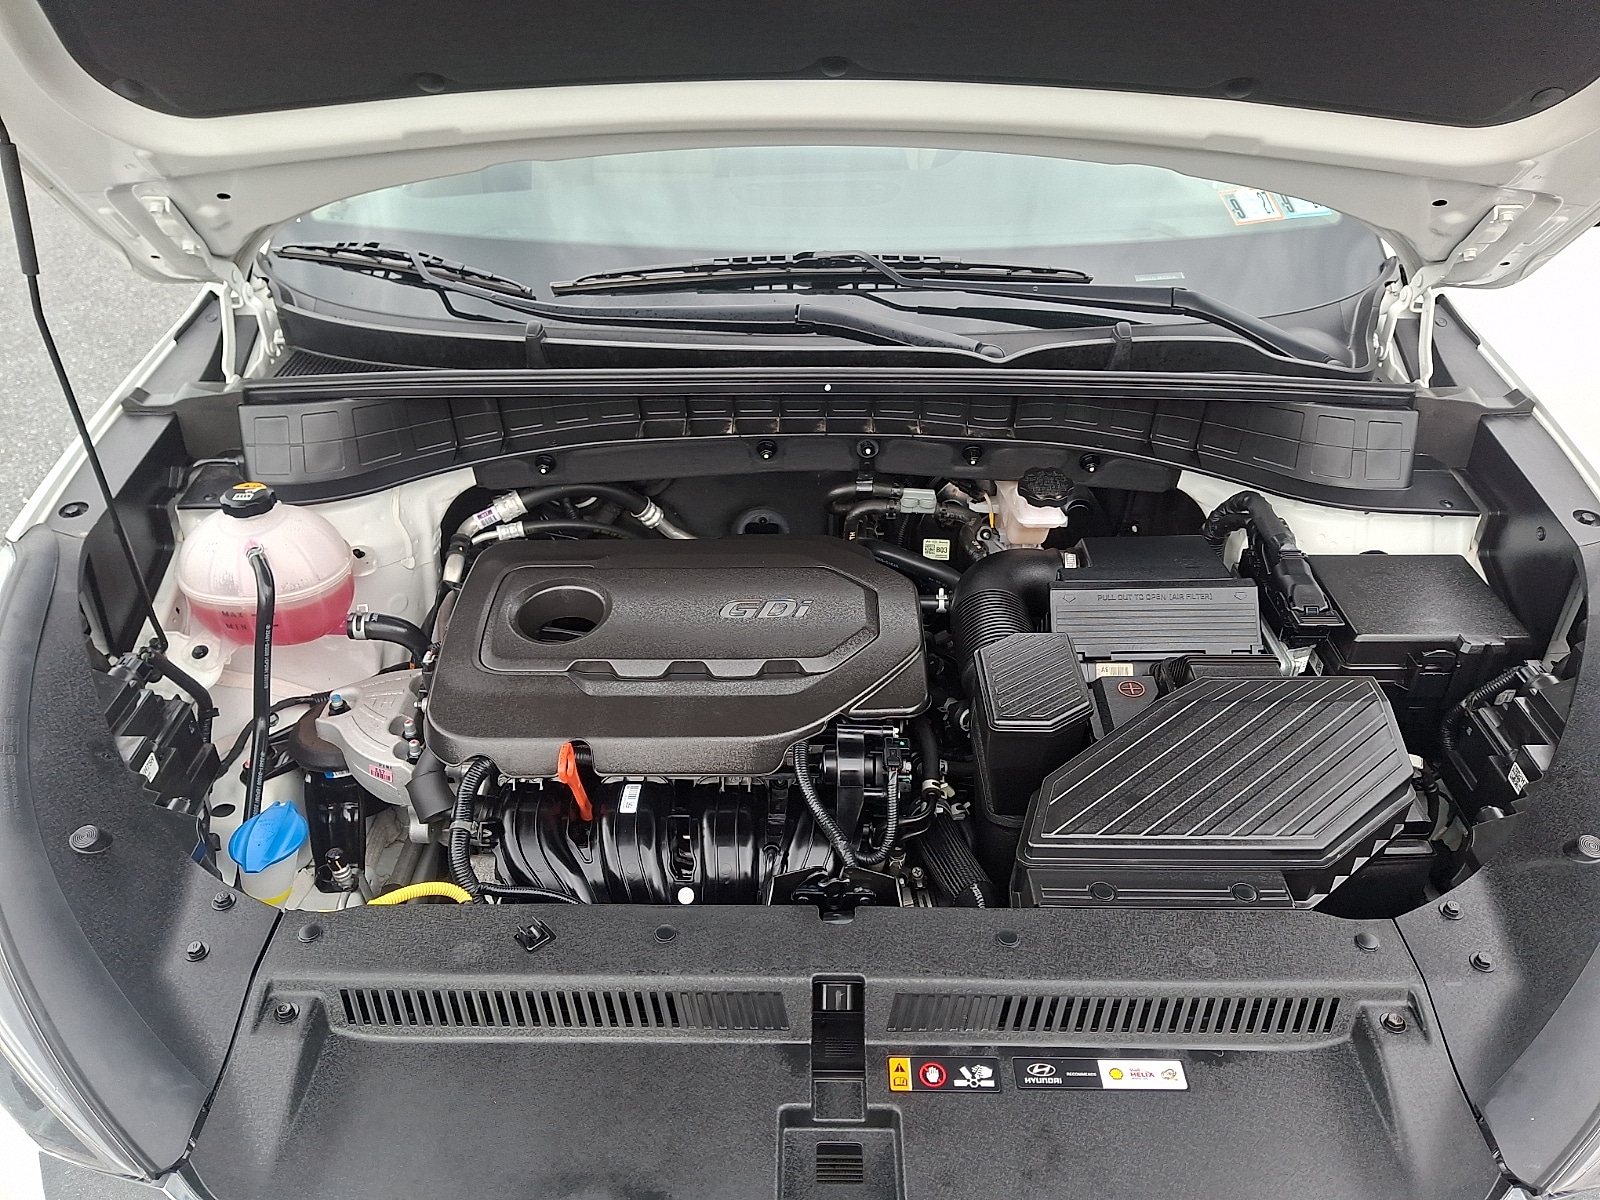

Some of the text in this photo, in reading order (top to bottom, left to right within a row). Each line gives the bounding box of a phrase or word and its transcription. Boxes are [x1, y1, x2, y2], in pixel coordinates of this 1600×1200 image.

[1097, 593, 1116, 601] PULL
[1117, 593, 1132, 601] OUT
[1134, 593, 1144, 601] TO
[1146, 593, 1166, 601] OPEN
[718, 598, 815, 619] GDi
[221, 610, 243, 618] MAX
[225, 623, 248, 631] MIN
